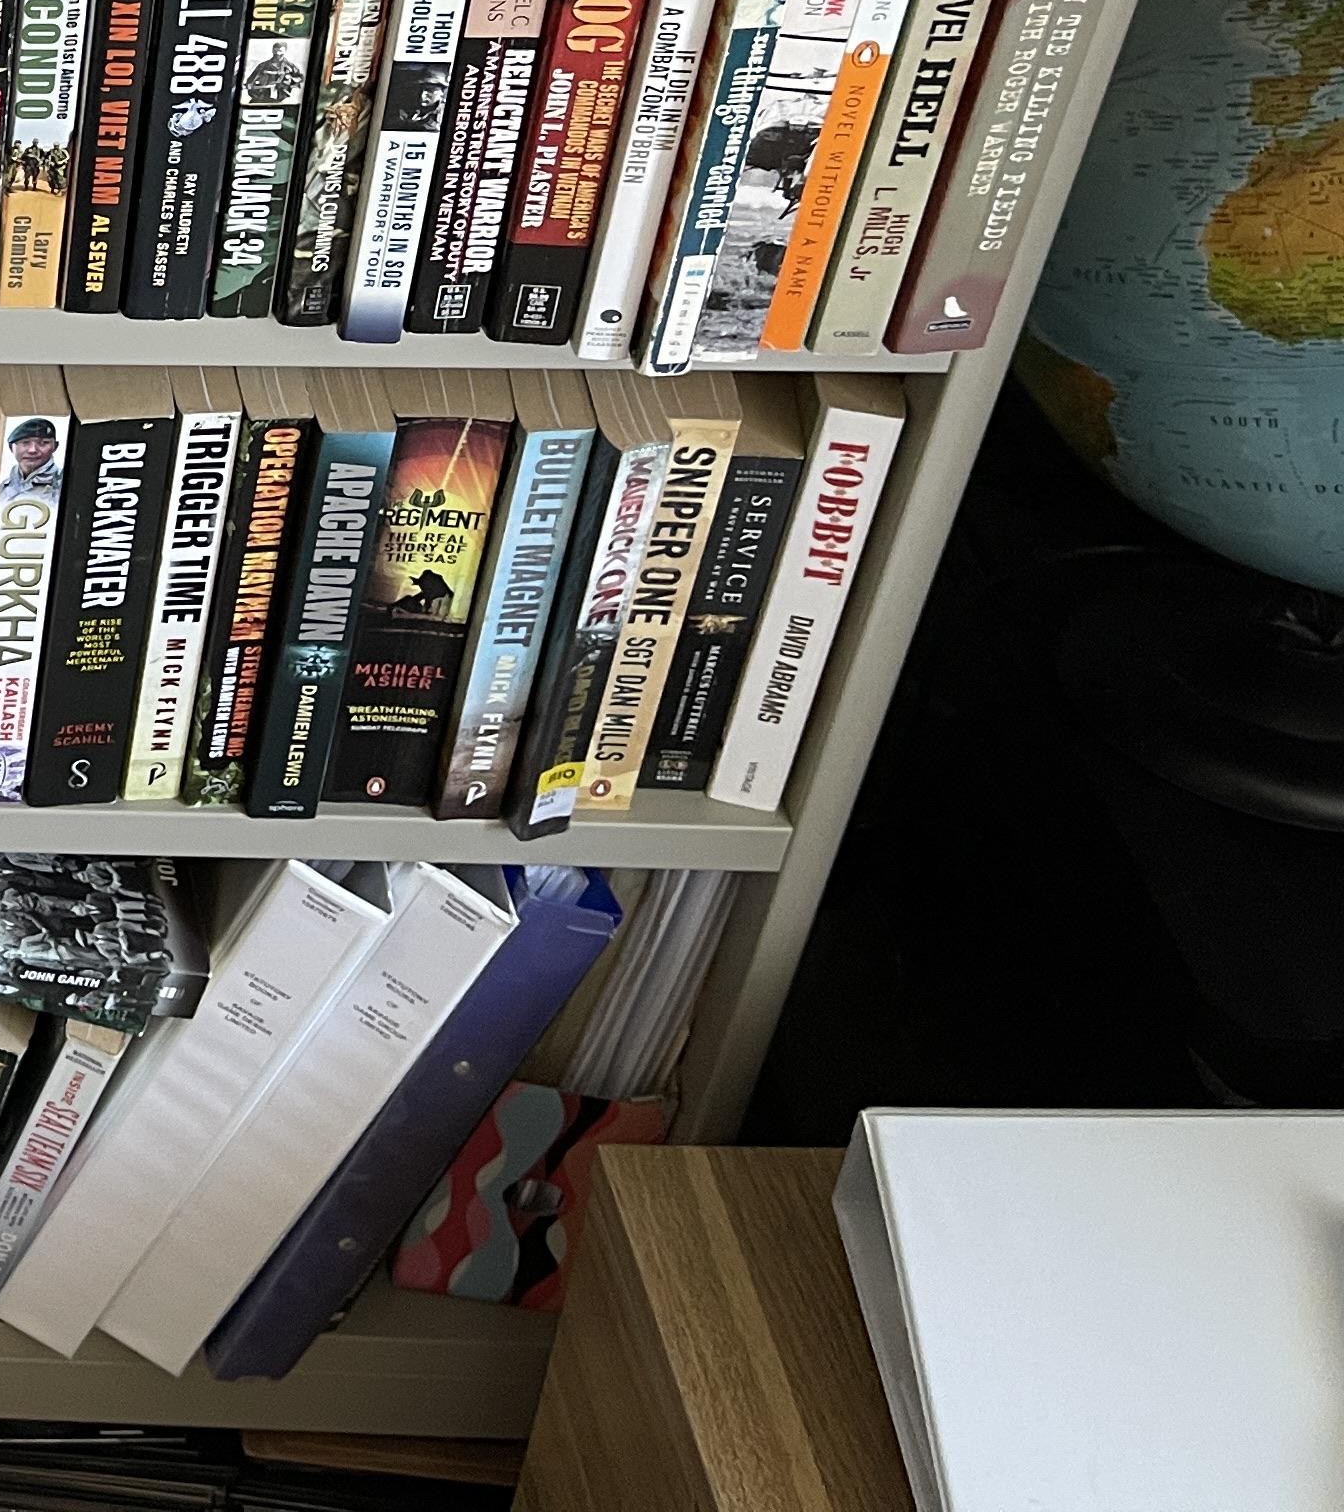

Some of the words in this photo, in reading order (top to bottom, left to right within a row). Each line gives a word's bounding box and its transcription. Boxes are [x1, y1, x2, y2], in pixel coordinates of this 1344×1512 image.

[168, 34, 226, 96] 488
[1210, 415, 1279, 429] SOUTH
[82, 442, 146, 610] BLACKWATER
[314, 462, 377, 564] APACHE
[646, 446, 716, 557] SNIPER
[298, 568, 358, 642] DAWN
[628, 563, 682, 626] ONE
[20, 969, 54, 983] JOHN
[57, 972, 100, 988] GARTH
